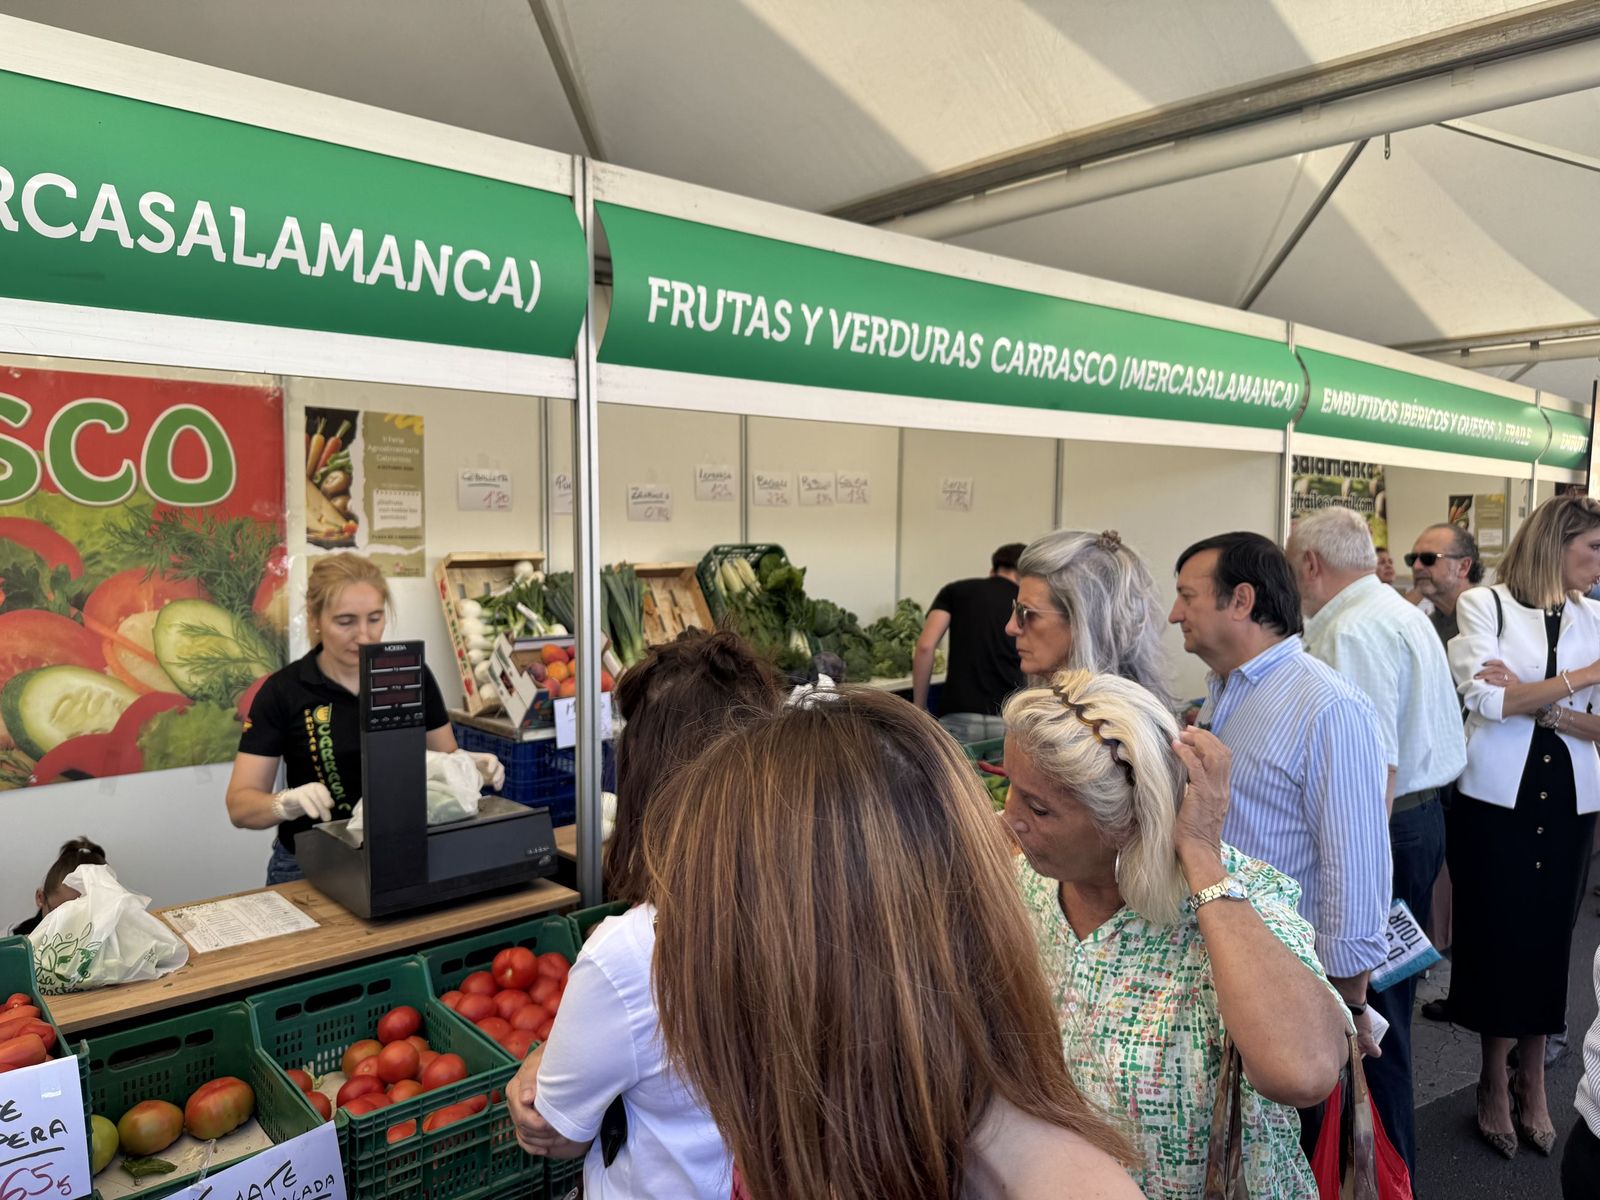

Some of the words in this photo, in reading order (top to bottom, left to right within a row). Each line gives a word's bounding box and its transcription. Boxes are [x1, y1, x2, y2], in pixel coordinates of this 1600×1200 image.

[648, 276, 793, 343] FRUTAS
[800, 304, 824, 346] Y
[828, 308, 984, 370] VERDURAS
[990, 336, 1118, 386] CARRASCO
[1119, 356, 1299, 411] (MERCASALAMANCA)
[1320, 387, 1399, 423] EMBUTIDOS
[1398, 398, 1450, 432] IBÉRICOS
[1449, 411, 1459, 433] Y
[1457, 414, 1496, 440] QUESOS
[318, 723, 352, 811] CARRAS
[1388, 911, 1423, 950] TOUR
